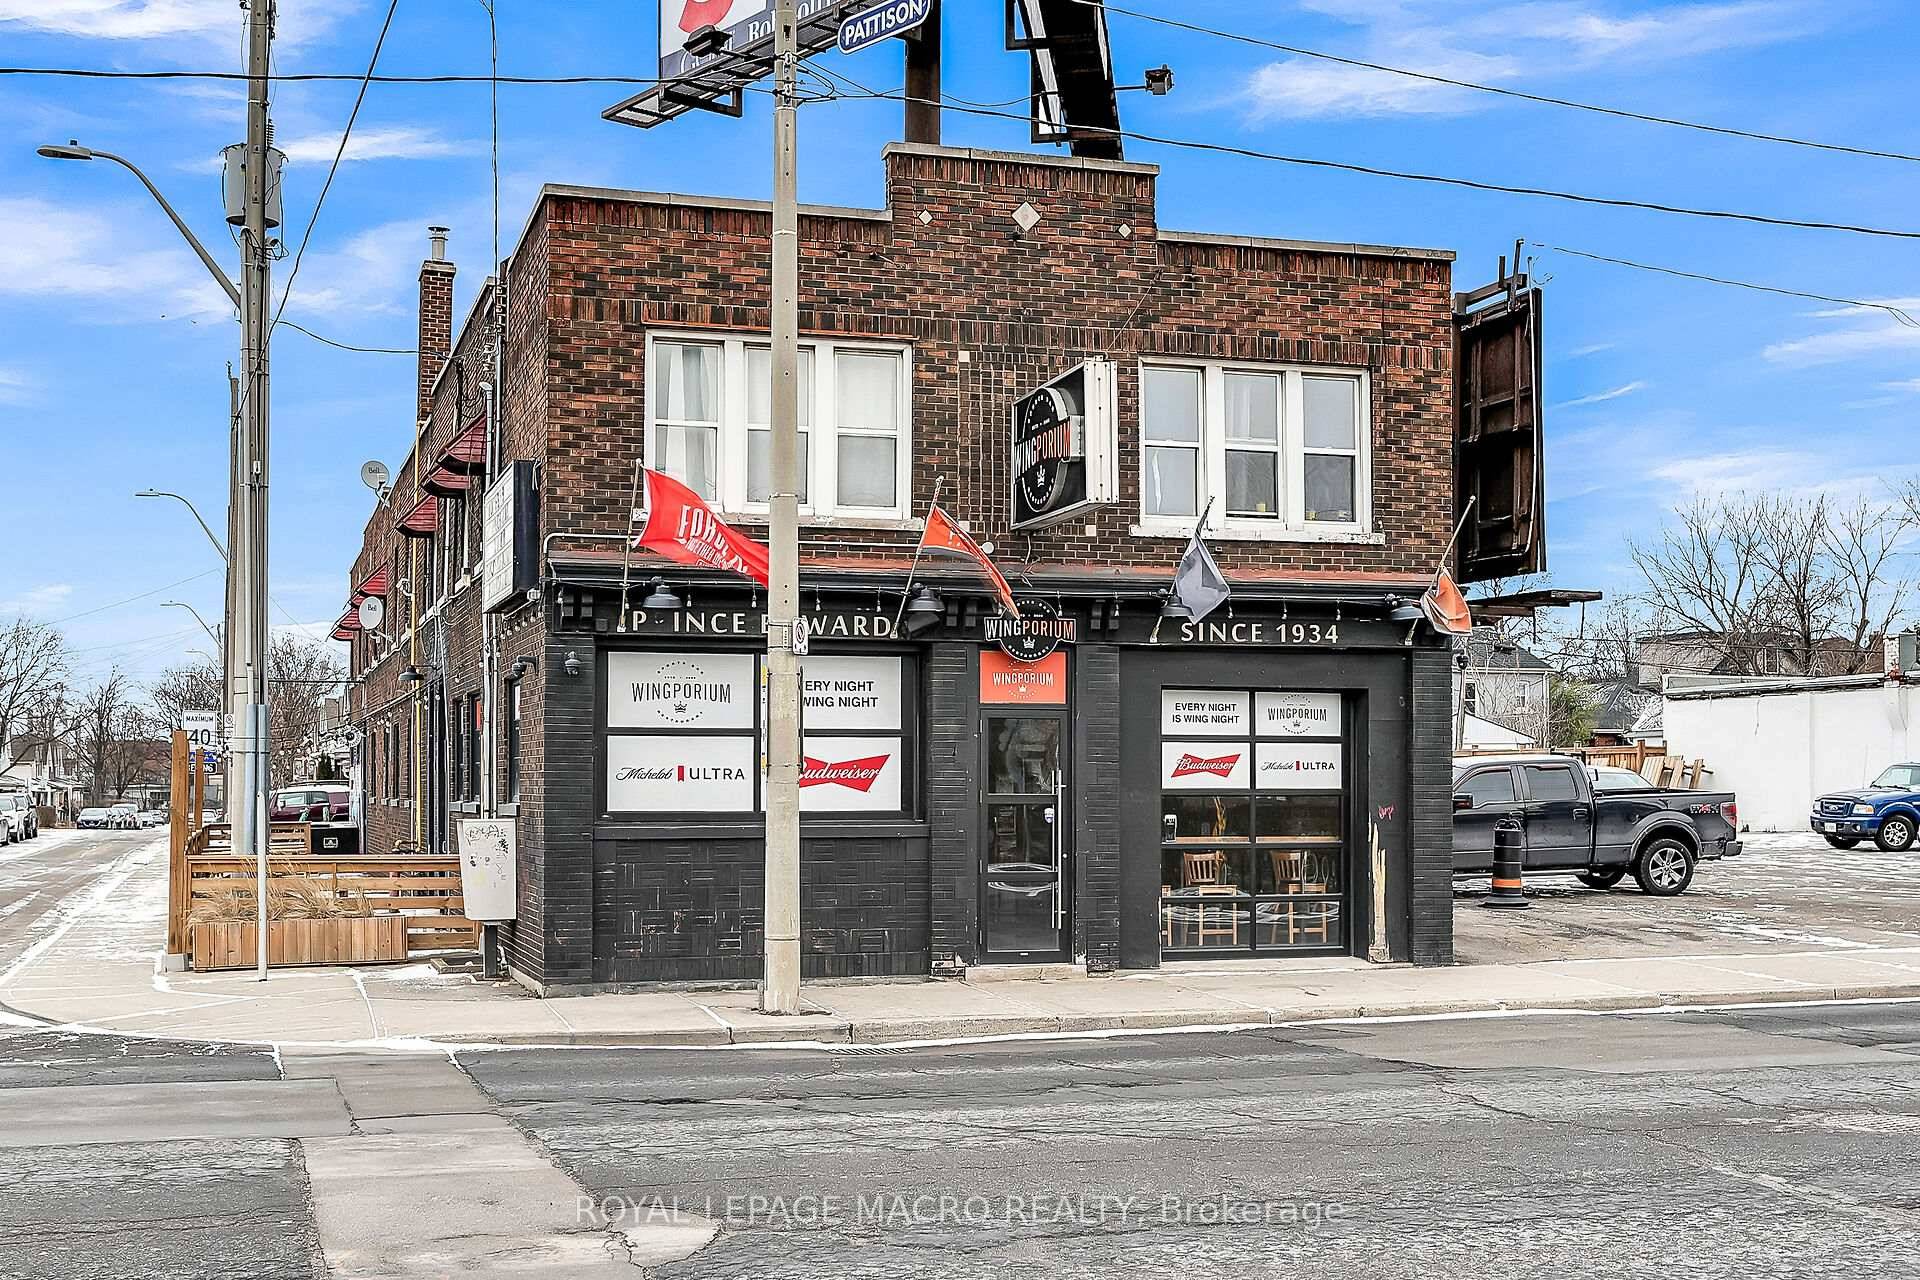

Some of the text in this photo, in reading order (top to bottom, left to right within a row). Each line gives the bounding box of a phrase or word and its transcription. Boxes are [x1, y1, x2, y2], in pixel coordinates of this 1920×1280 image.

[845, 0, 923, 46] PATTISON
[1014, 420, 1071, 482] WINGPORIUM
[632, 611, 891, 637] PINCE EWARD
[986, 619, 1074, 641] WINGPORIUM
[1181, 622, 1338, 644] SINCE 1934
[834, 681, 874, 692] NIGHT
[993, 672, 1054, 687] WINGPORIUM
[632, 682, 731, 703] WINGPORIUM
[838, 697, 879, 708] NIGHT
[1175, 702, 1237, 712] EVERY NIGHT
[1172, 714, 1240, 724] IS WING NIGHT
[1268, 707, 1327, 722] WINGPORIUM
[188, 729, 211, 745] 40
[1177, 757, 1236, 771] Budweiser
[1302, 762, 1335, 771] ULTRA
[616, 767, 745, 781] Michelob ULTRA
